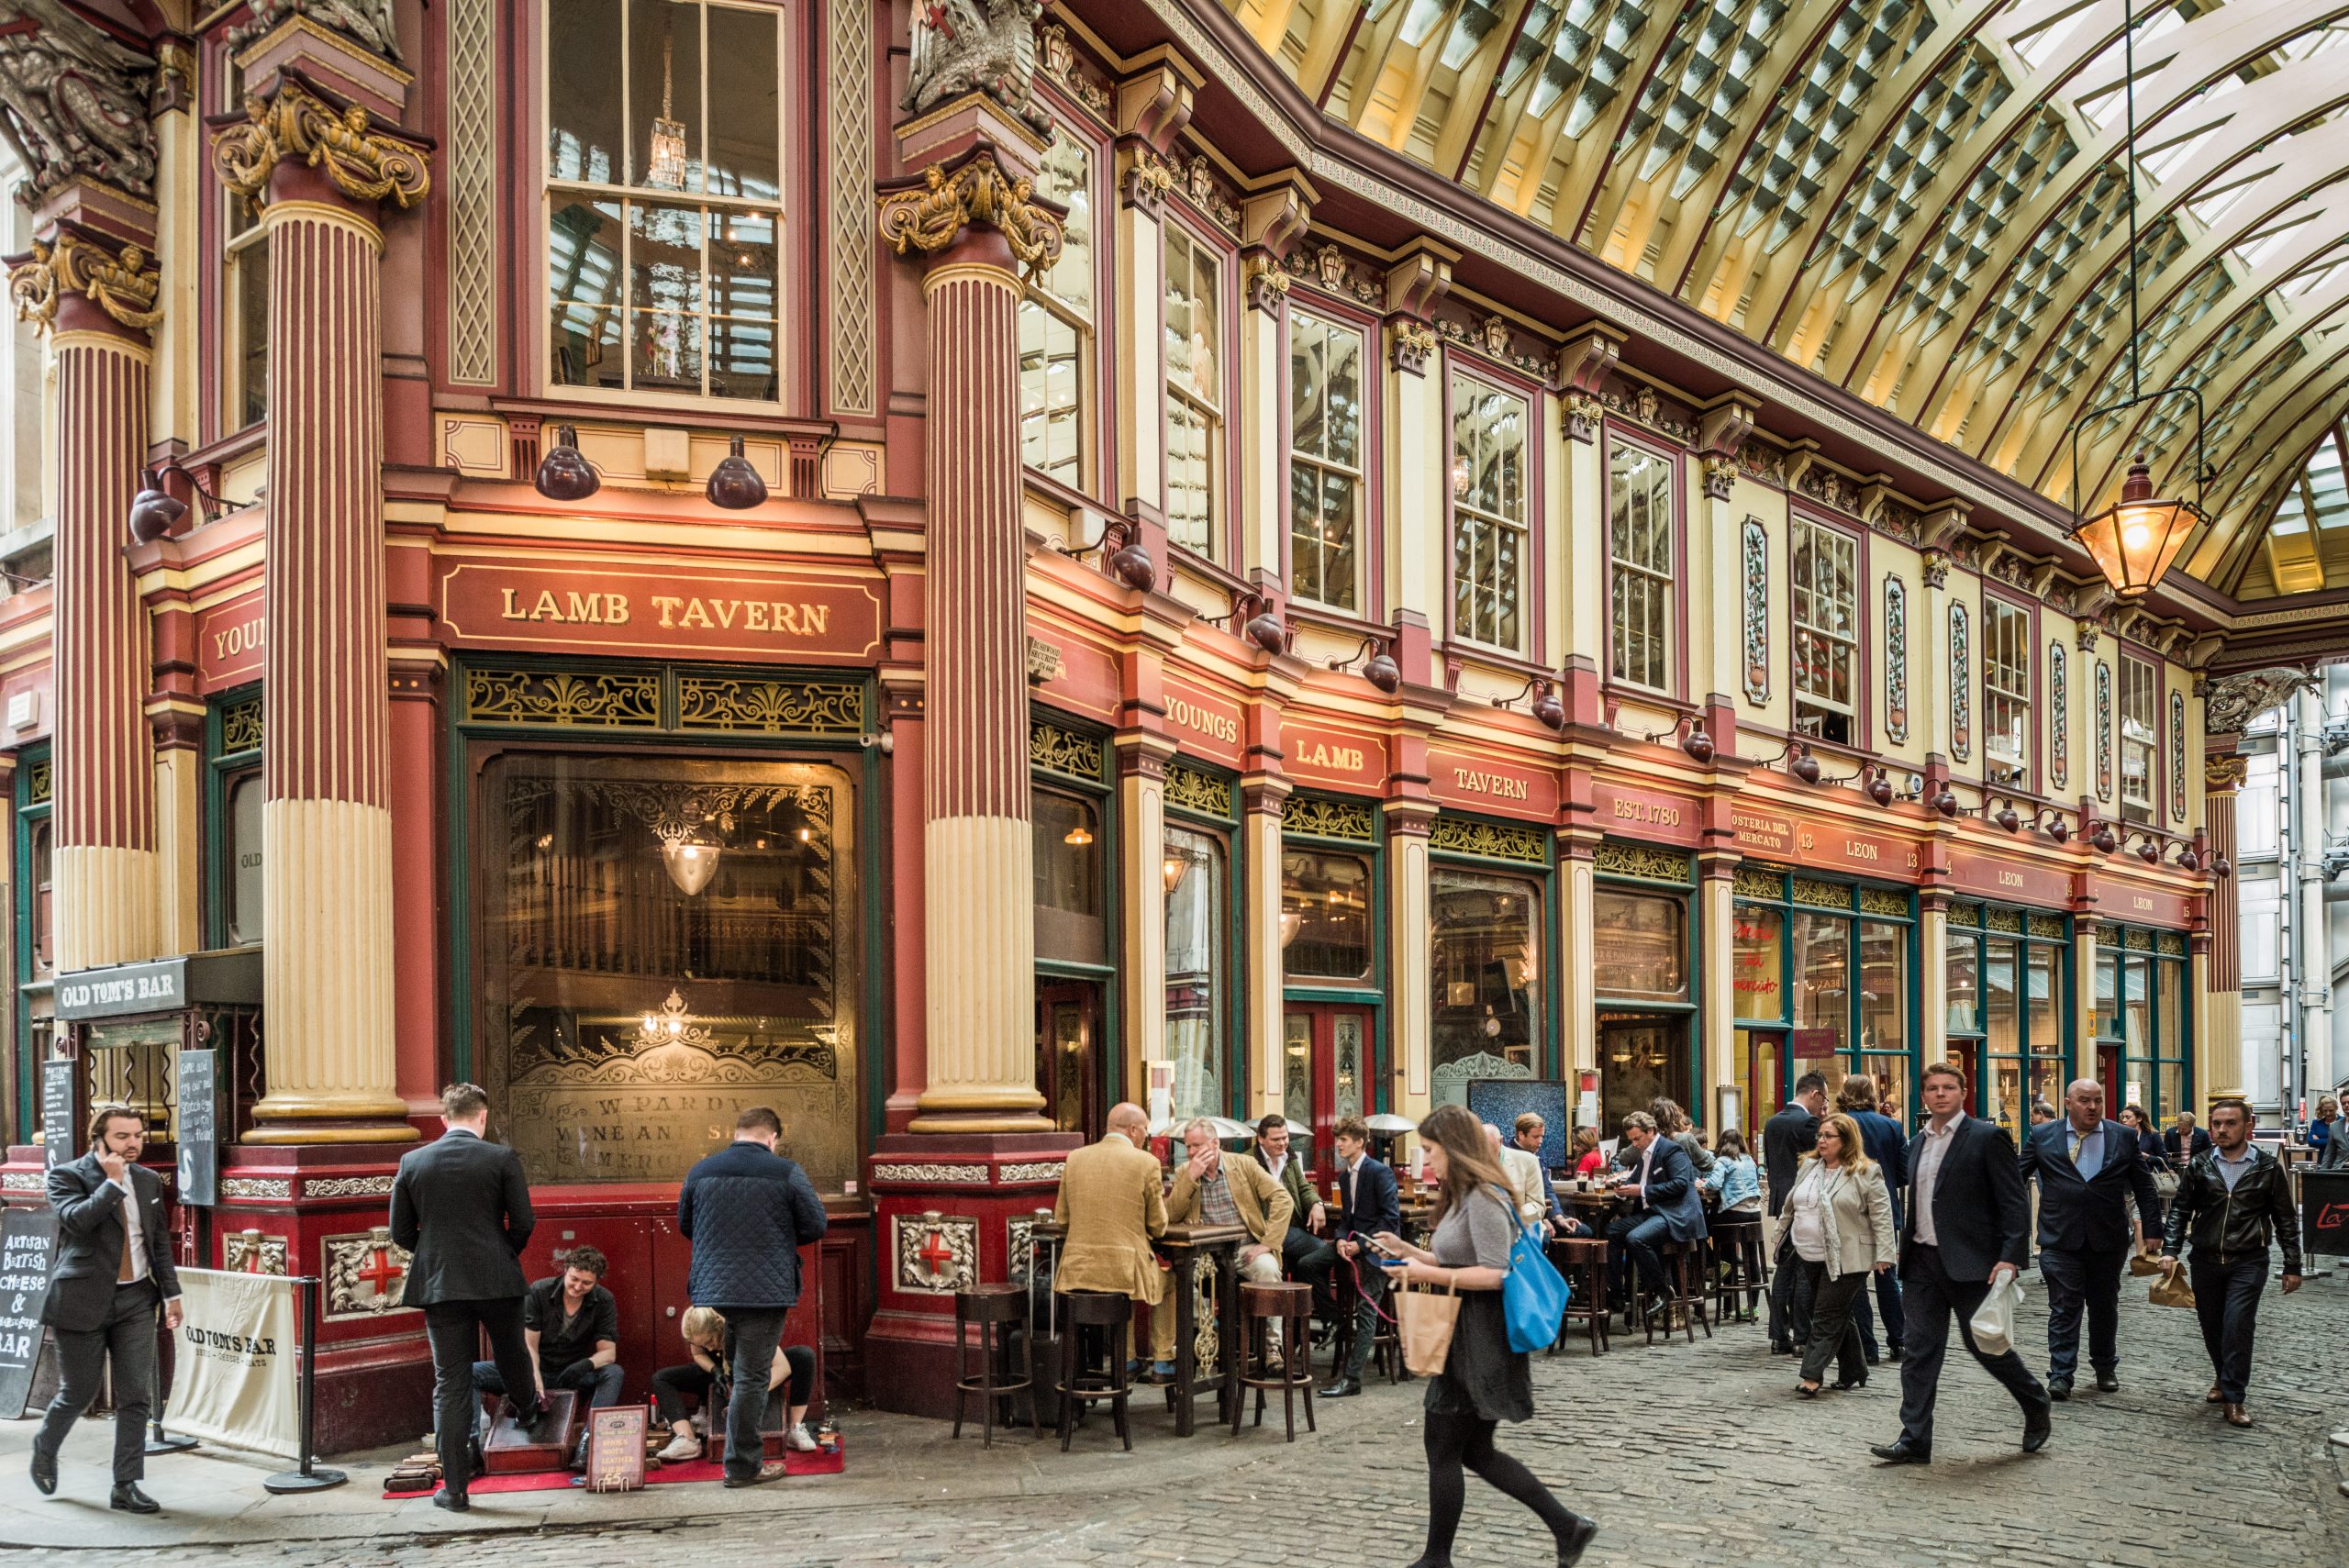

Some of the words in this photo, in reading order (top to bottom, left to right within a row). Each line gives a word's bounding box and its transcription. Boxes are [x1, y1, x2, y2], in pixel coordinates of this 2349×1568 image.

[502, 588, 631, 625] LAMB
[651, 595, 829, 635] TAVERN
[1030, 650, 1058, 665] SECURITY
[1163, 695, 1237, 744] YOUNGS
[1297, 740, 1364, 771] LAMB
[1454, 768, 1528, 801] TAVERN
[1731, 815, 1770, 831] OSTERIA
[1773, 822, 1789, 836] DEL
[1739, 830, 1781, 849] MERCATO
[1801, 833, 1813, 850] 13
[1846, 841, 1878, 861] LEON
[1907, 852, 1918, 869] 13
[241, 852, 262, 868] OLD
[1998, 871, 2023, 887] LEON
[2065, 883, 2073, 897] 14
[2133, 896, 2153, 910] LEON
[2183, 906, 2190, 917] 15
[61, 985, 90, 1007] OLD
[92, 979, 135, 1004] TOM'S
[138, 974, 174, 999] BAR
[556, 1125, 625, 1141] WNE
[11, 1293, 26, 1313] &
[186, 1325, 205, 1344] OLD
[206, 1329, 242, 1352] TOM'S
[244, 1336, 277, 1356] BAR
[605, 1473, 621, 1485] £5
